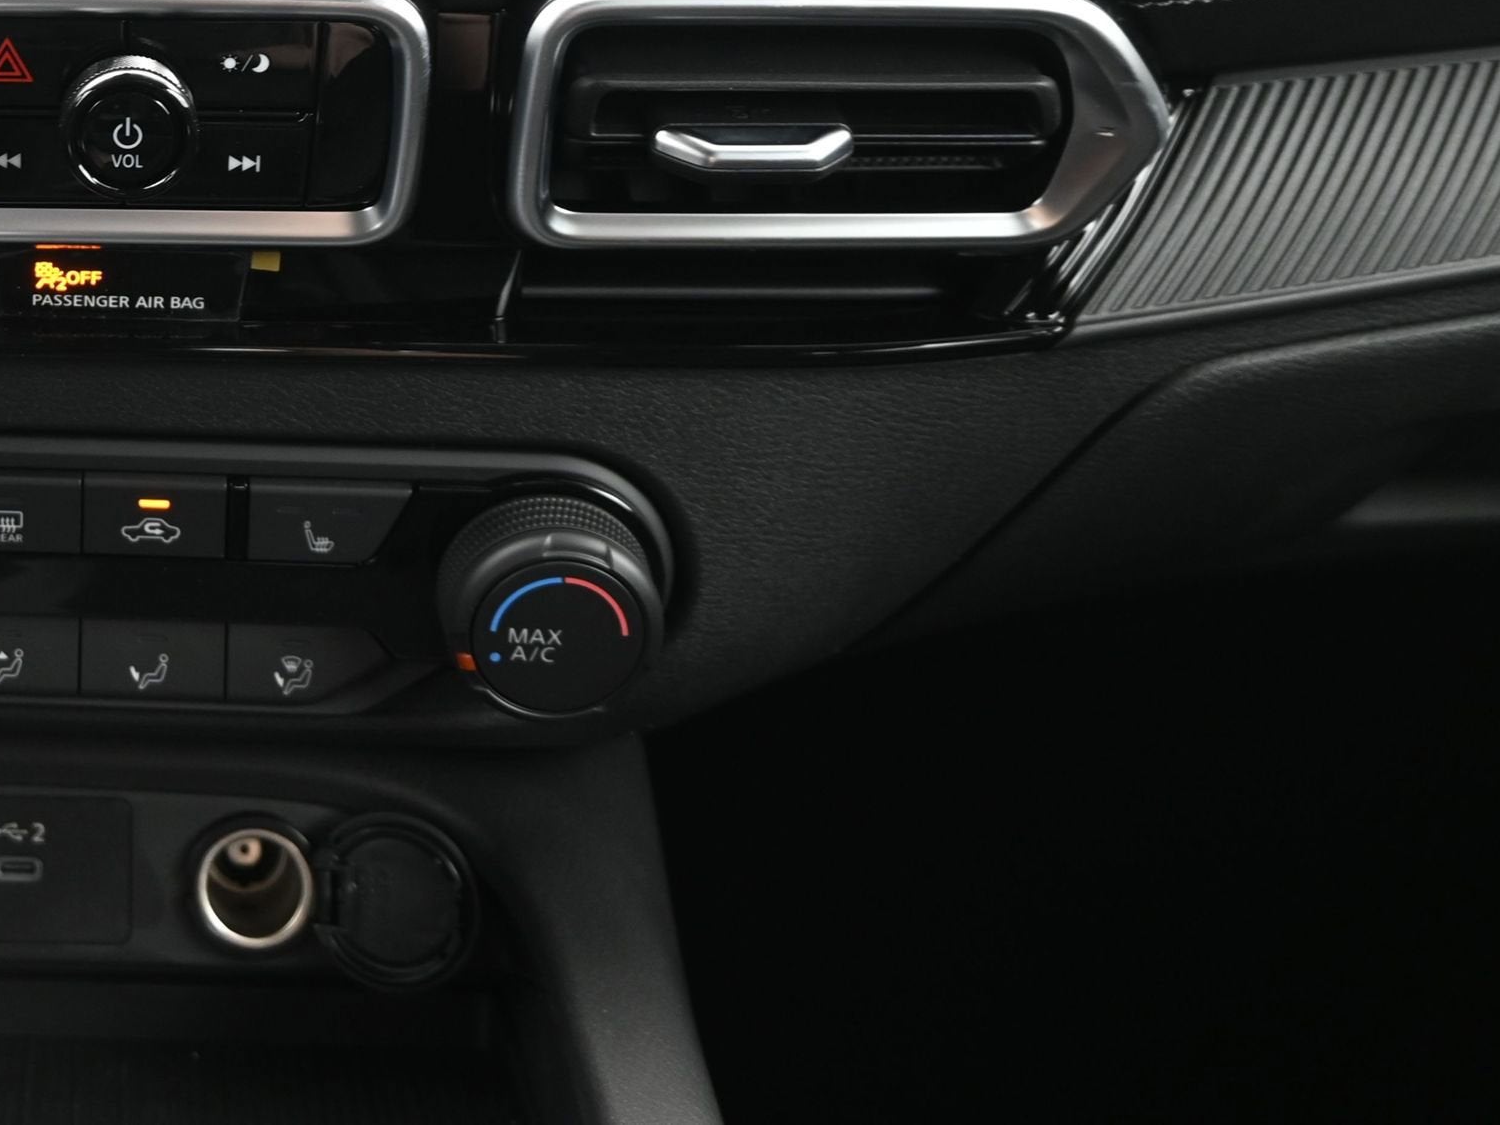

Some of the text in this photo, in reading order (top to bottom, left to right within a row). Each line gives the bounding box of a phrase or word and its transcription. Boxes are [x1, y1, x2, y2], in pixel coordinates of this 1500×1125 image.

[111, 154, 143, 168] VOL
[32, 294, 205, 309] PASSENGER AIR BAG
[507, 627, 562, 646] MAX
[509, 645, 556, 663] A/C
[31, 821, 46, 843] 2
